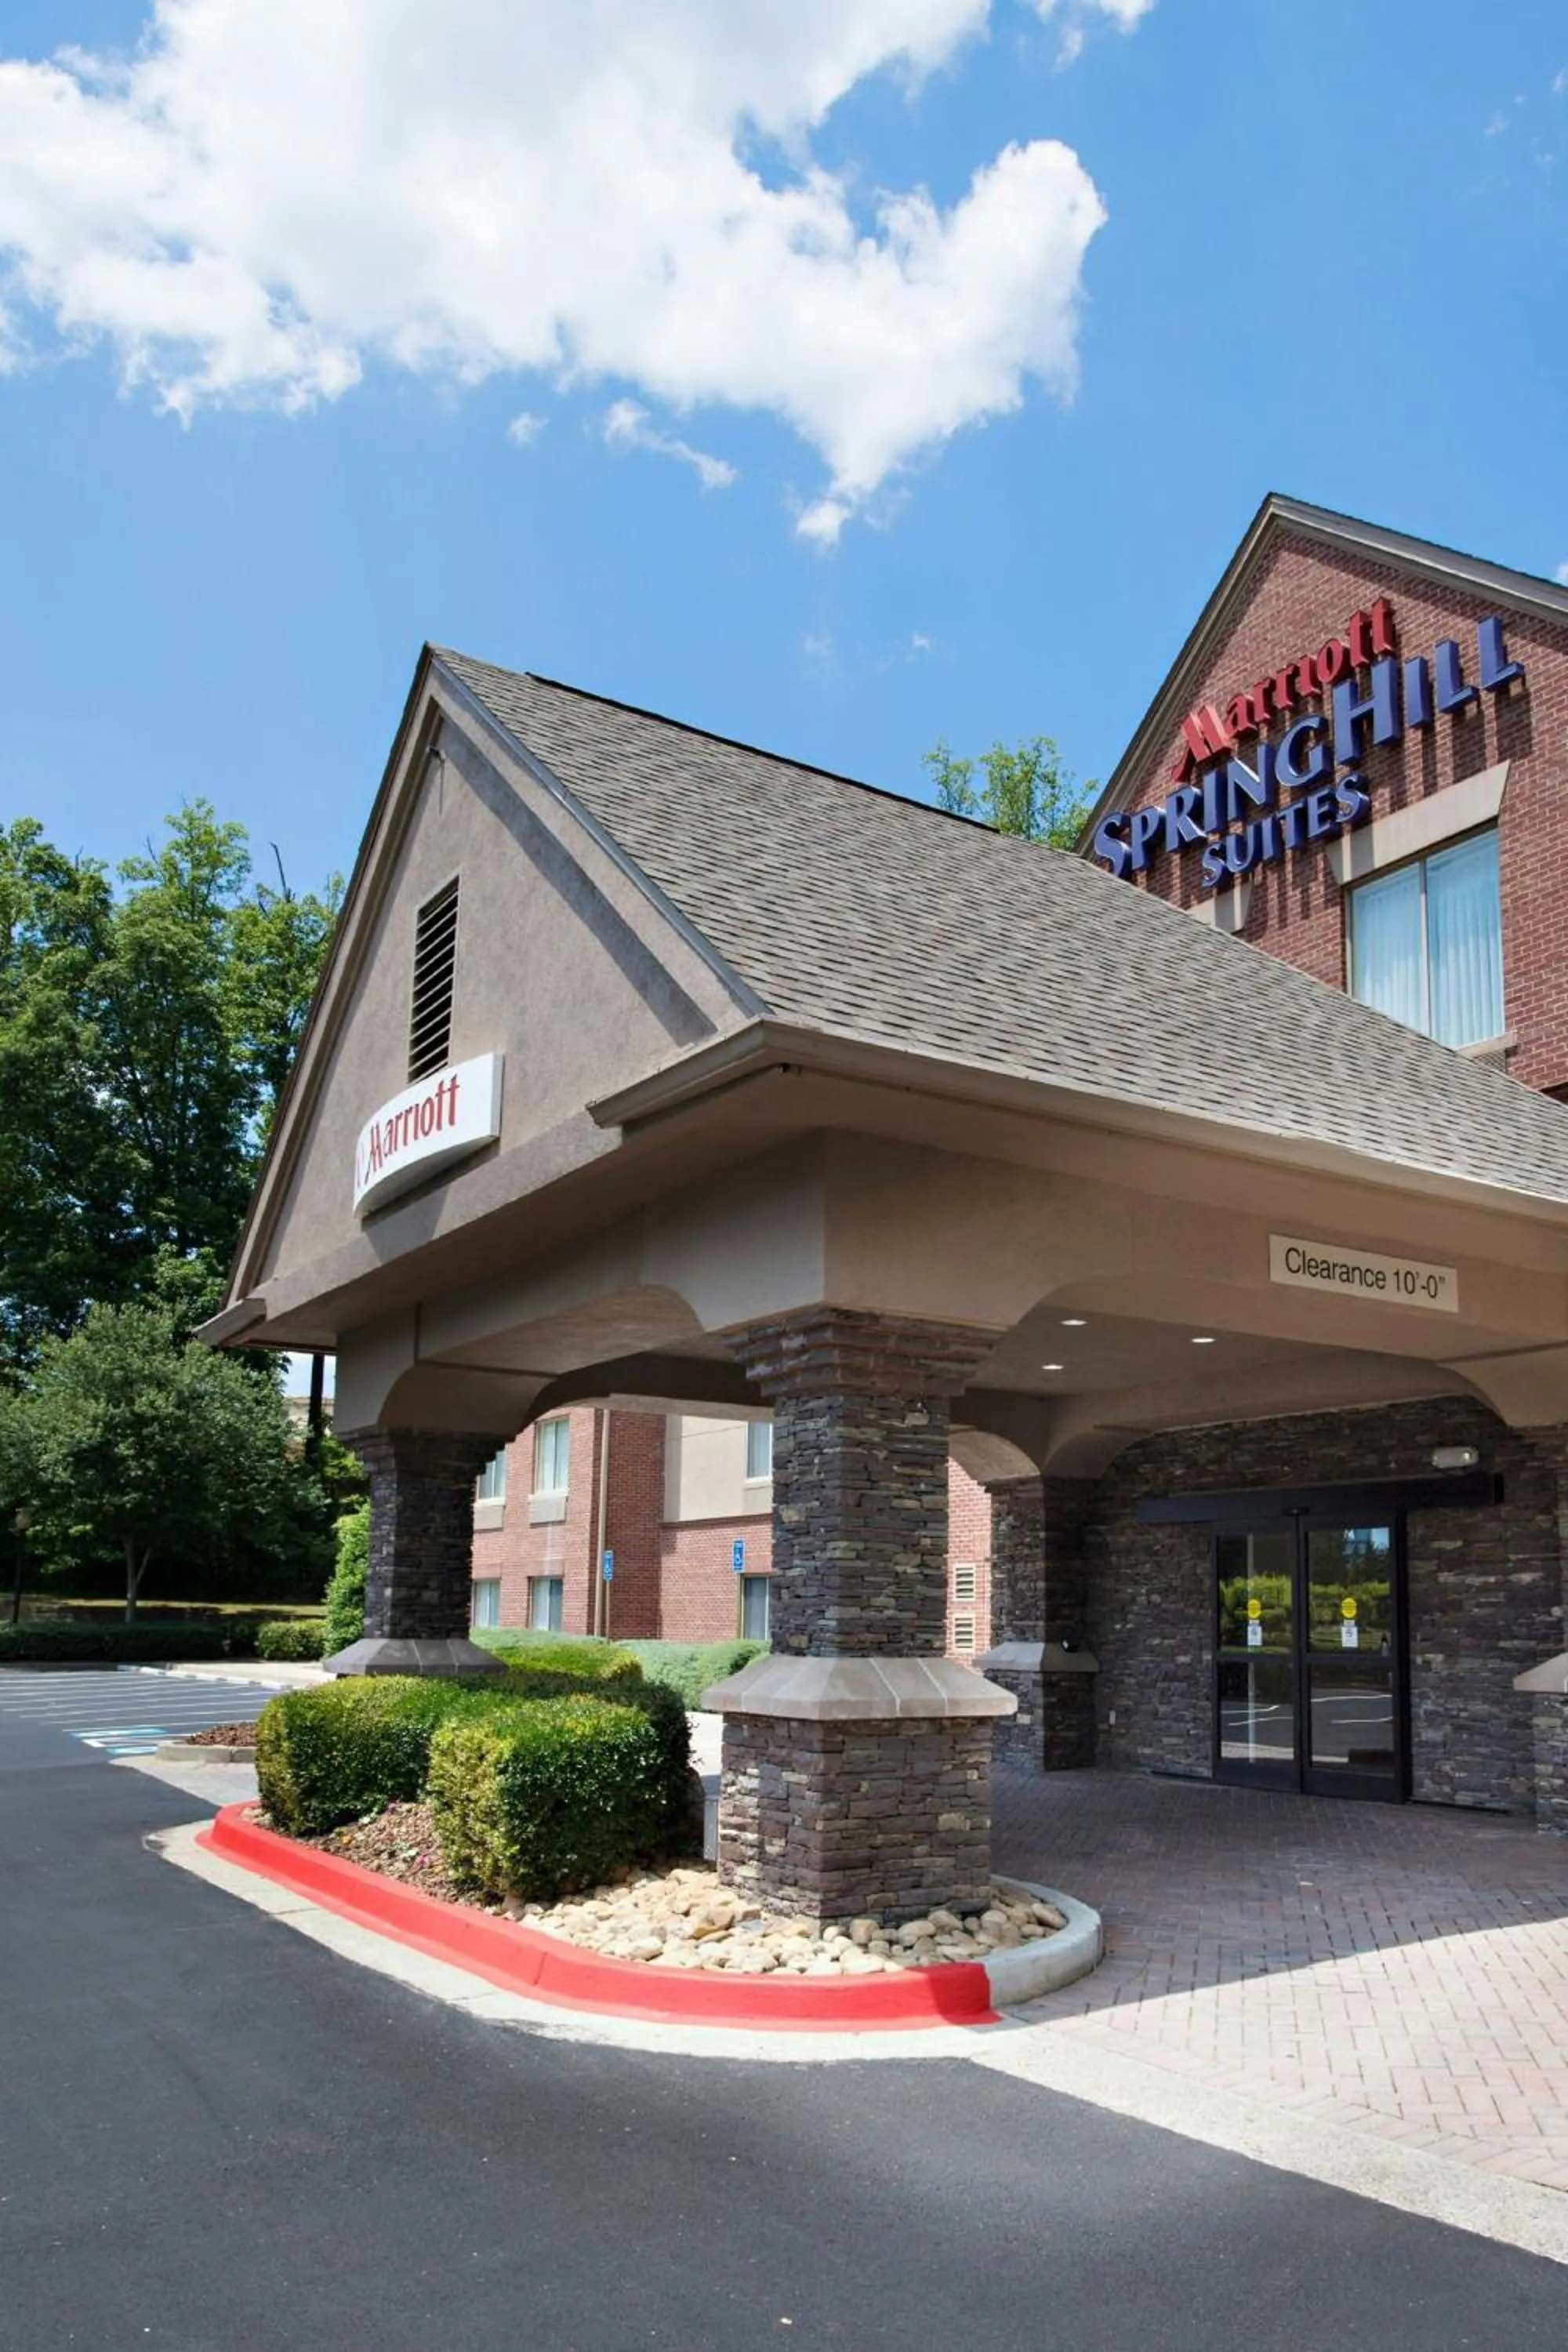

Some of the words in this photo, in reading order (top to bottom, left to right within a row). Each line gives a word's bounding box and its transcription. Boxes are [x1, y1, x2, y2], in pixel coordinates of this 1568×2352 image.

[1094, 615, 1525, 877] SPRINGHILL
[1171, 597, 1396, 782] Marriott
[1202, 773, 1370, 888] SUITES
[365, 1074, 459, 1185] Marriott
[1285, 1247, 1387, 1290] Clearance
